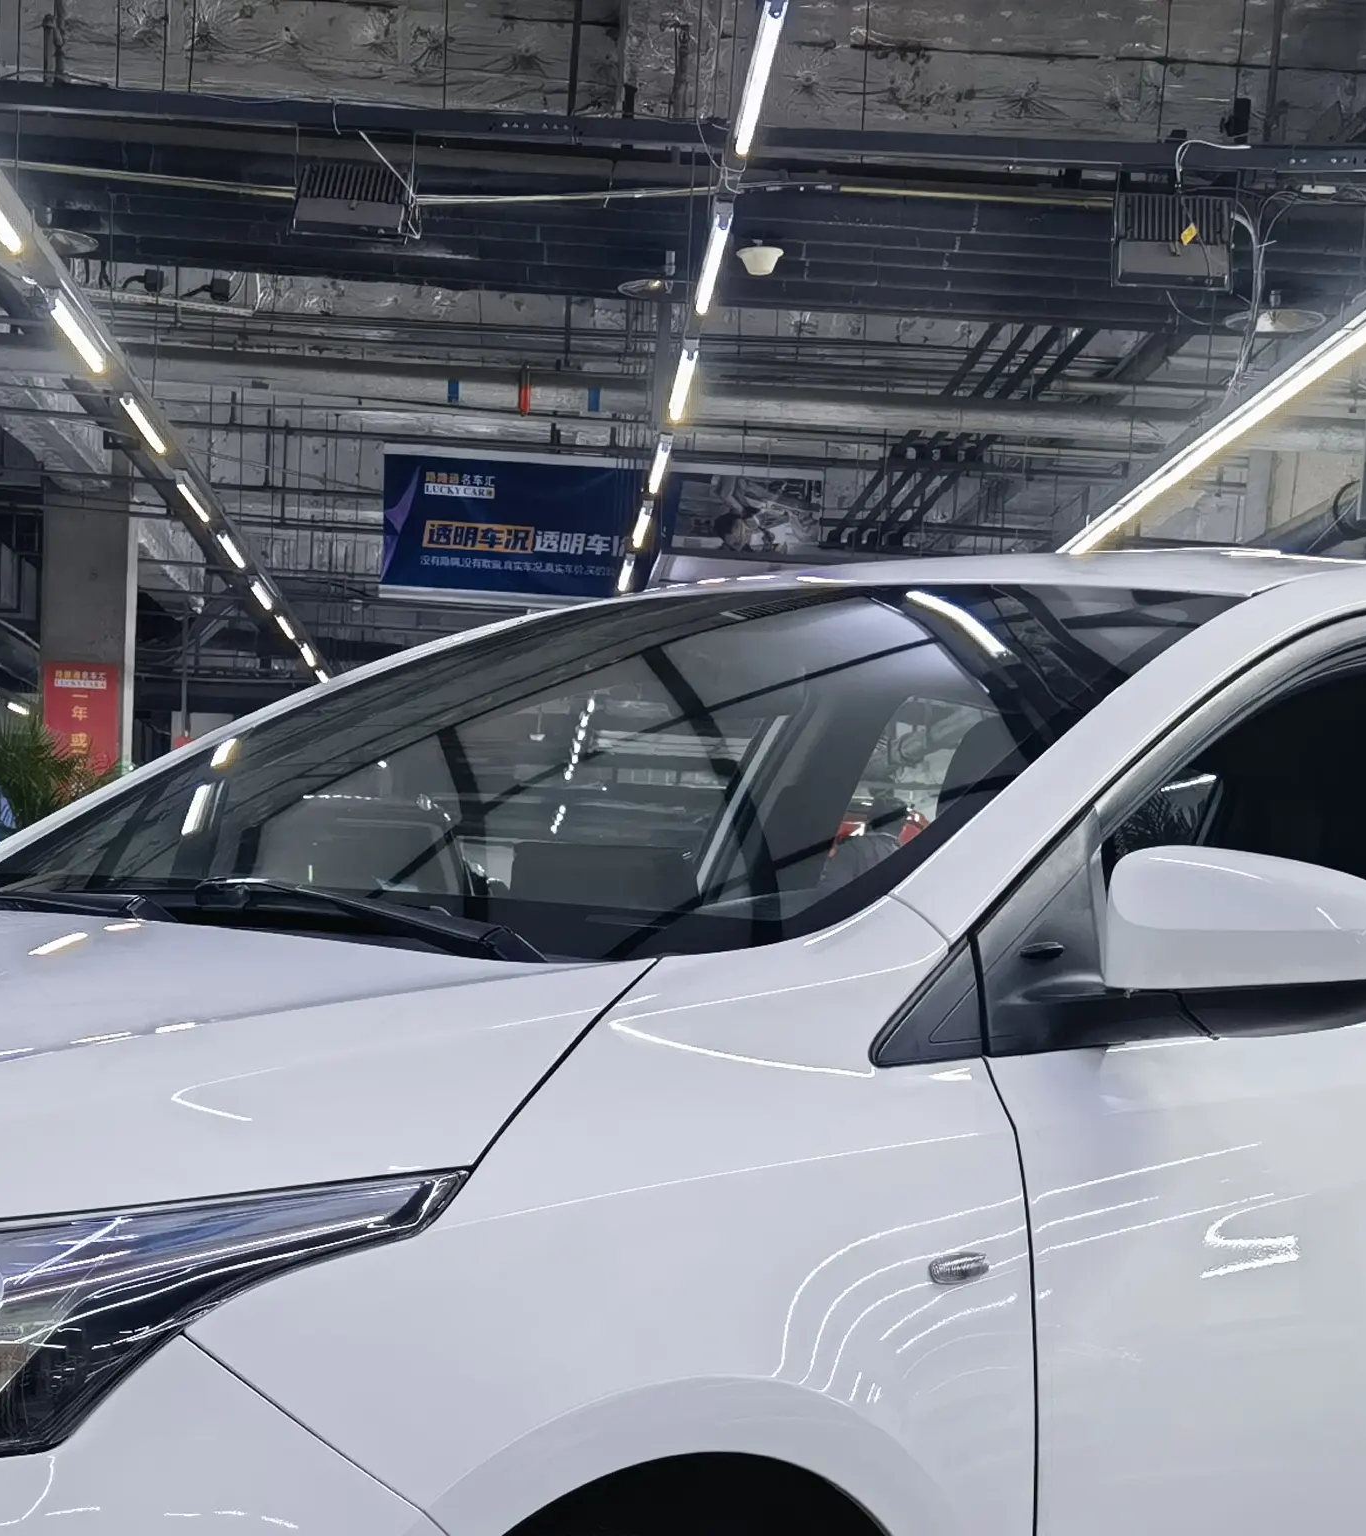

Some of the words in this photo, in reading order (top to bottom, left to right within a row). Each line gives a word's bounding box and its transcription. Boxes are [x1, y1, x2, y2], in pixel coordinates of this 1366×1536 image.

[425, 485, 463, 495] LUCKY
[463, 487, 485, 497] CAR
[427, 522, 529, 551] 透明车况
